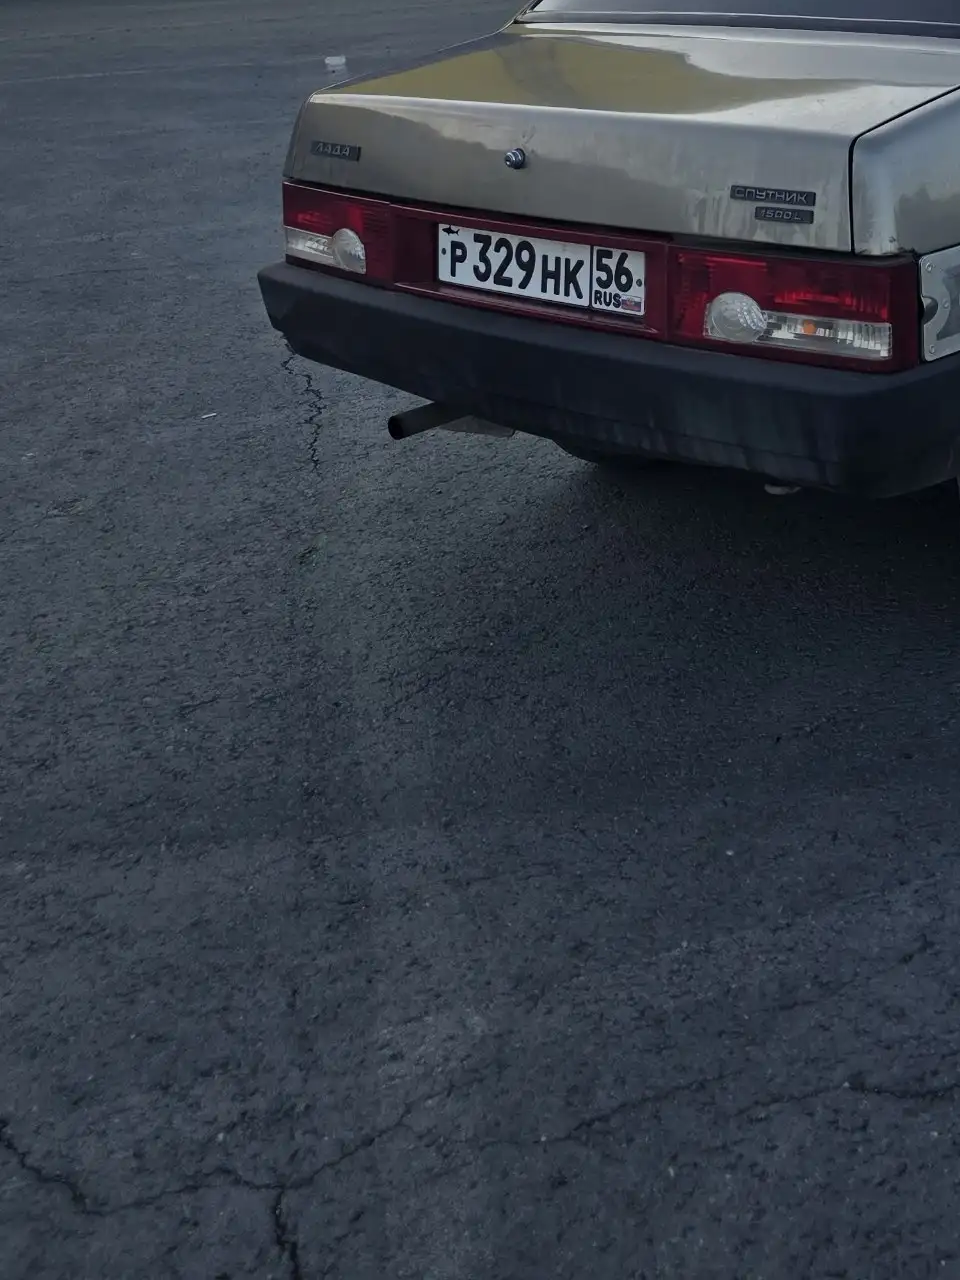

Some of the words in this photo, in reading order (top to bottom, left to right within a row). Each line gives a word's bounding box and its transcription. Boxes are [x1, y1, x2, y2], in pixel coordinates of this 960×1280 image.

[734, 187, 807, 204] СПУТНИК
[595, 248, 634, 293] 56
[593, 289, 622, 309] RUS
